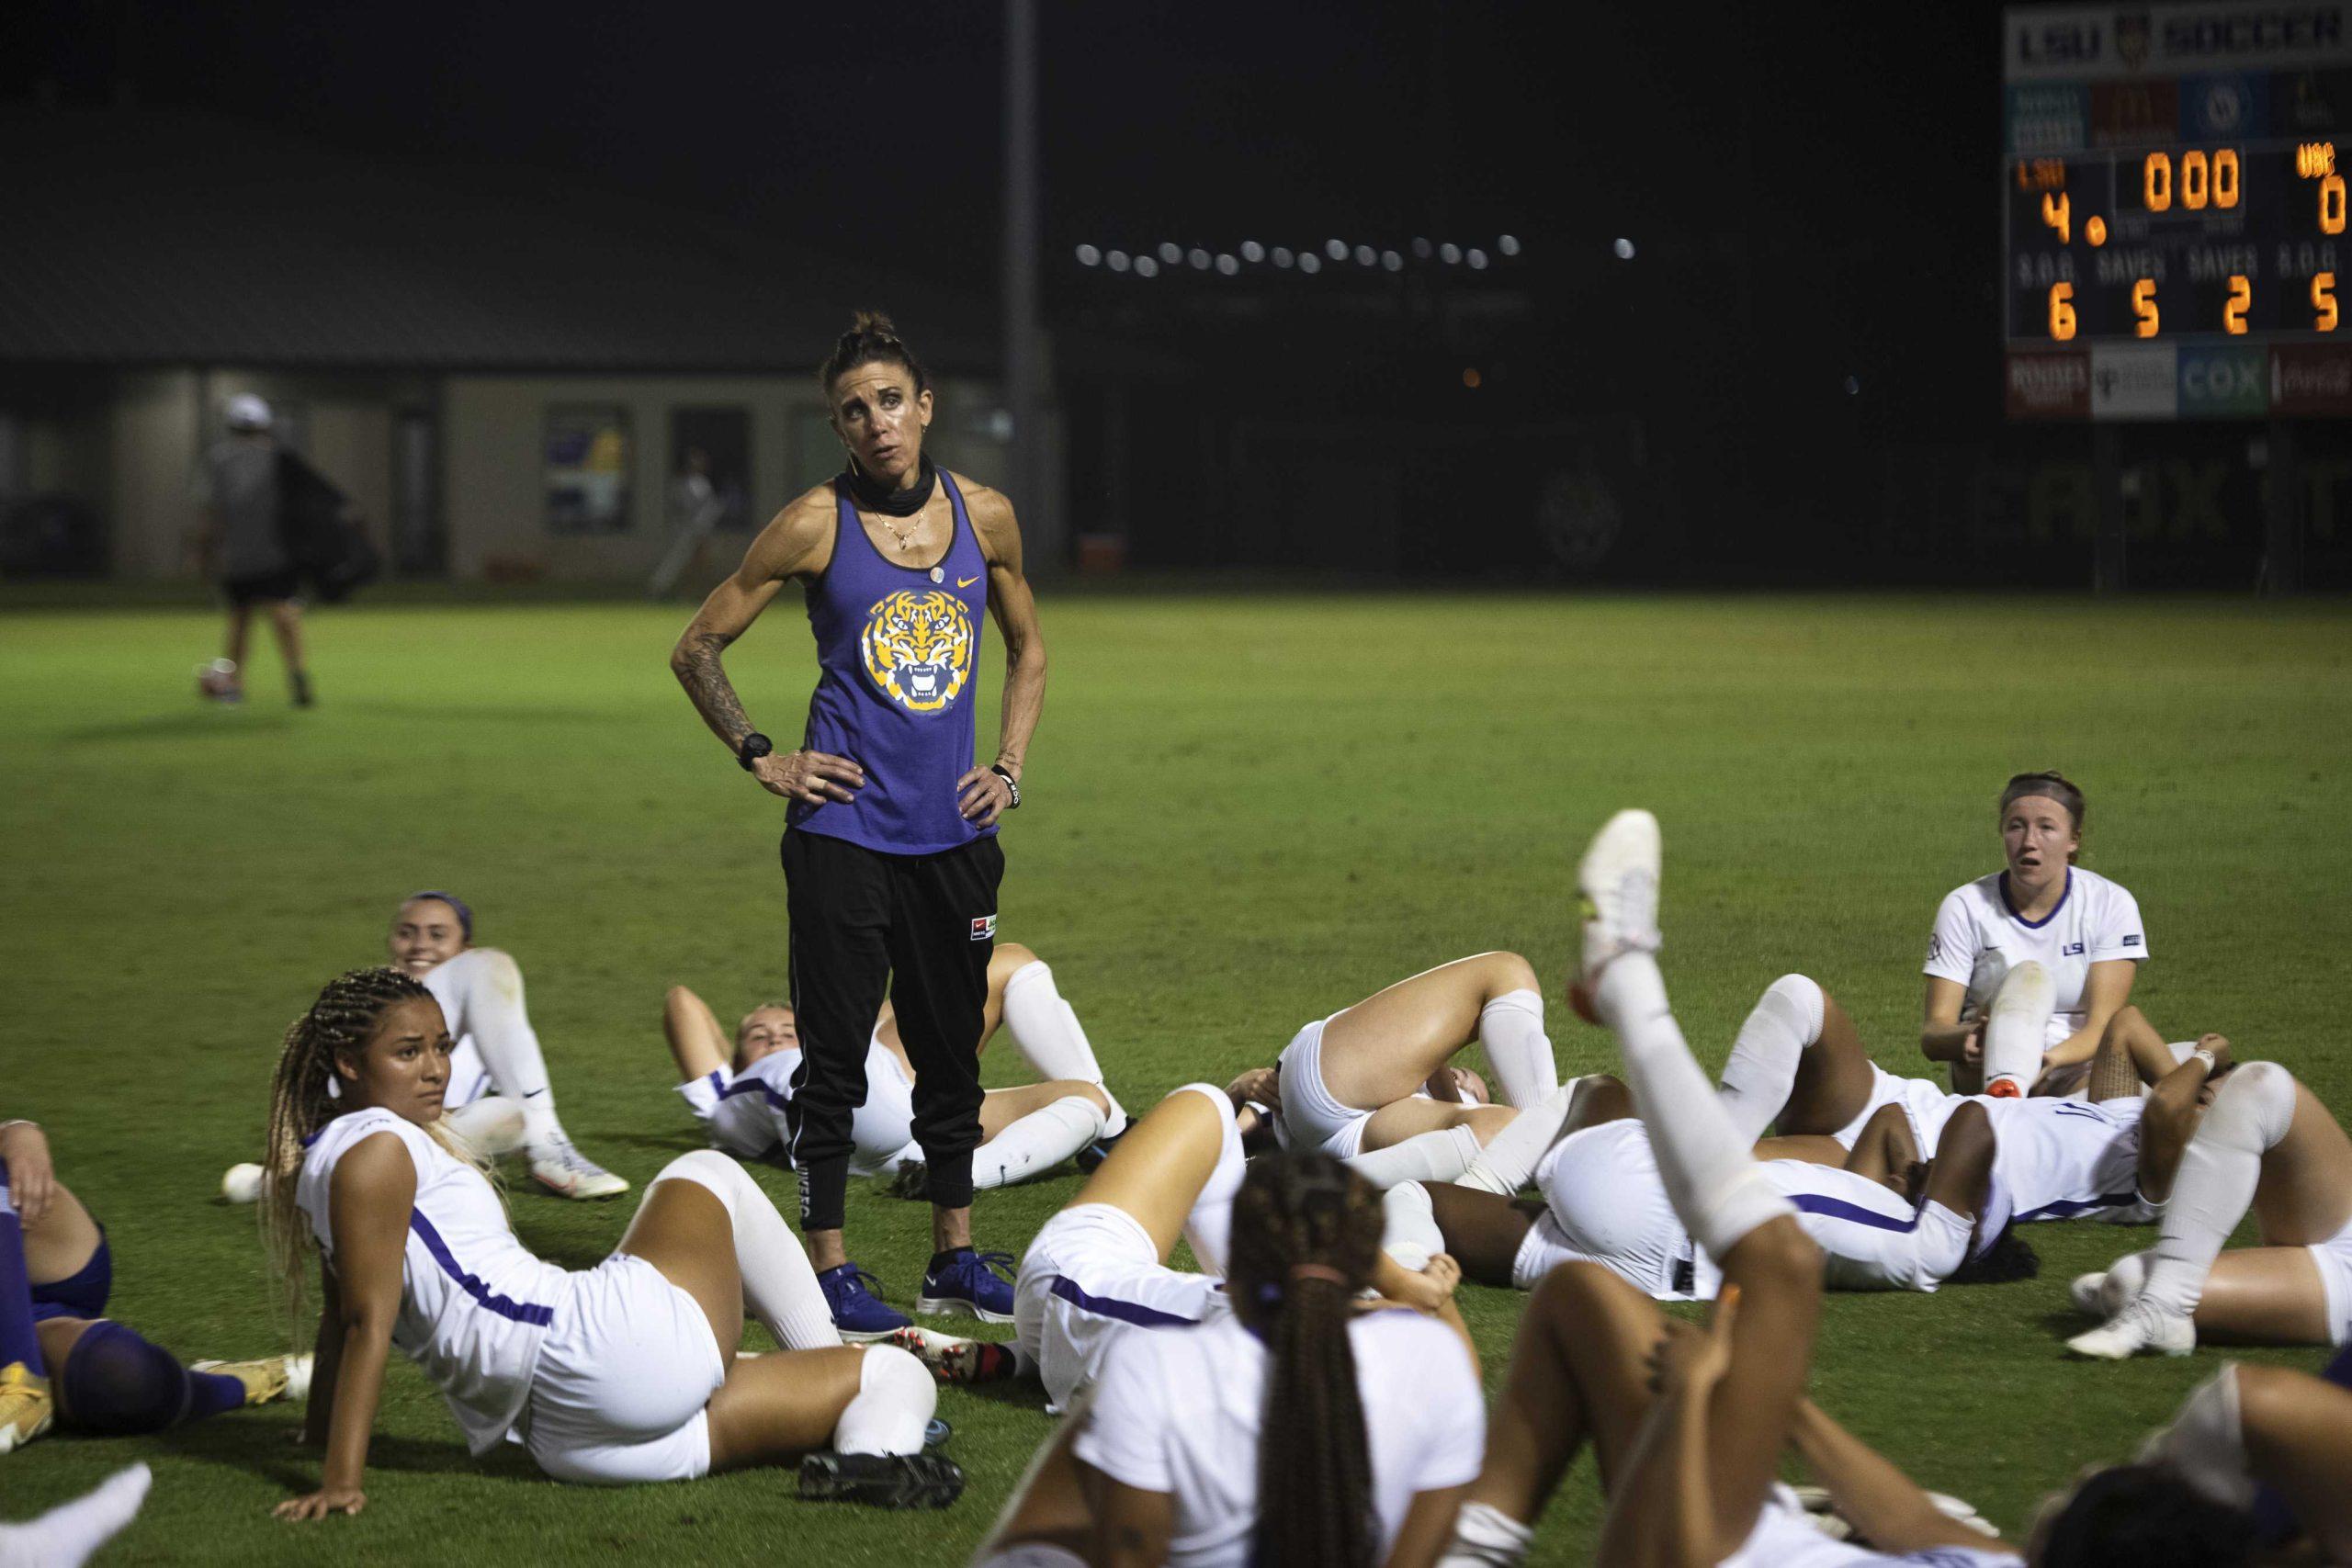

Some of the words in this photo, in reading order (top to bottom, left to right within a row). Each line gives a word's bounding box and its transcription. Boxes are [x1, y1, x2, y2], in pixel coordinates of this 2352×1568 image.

[2018, 23, 2102, 64] LSU
[2163, 6, 2343, 59] SOCCER
[2317, 175, 2346, 235] 0
[2096, 245, 2166, 287] SAVES
[2187, 241, 2257, 282] SAVES
[2048, 281, 2076, 342] 6
[2131, 278, 2159, 338] 5
[2223, 275, 2251, 334] 2
[2310, 272, 2338, 332] 5
[2183, 358, 2261, 399] COX
